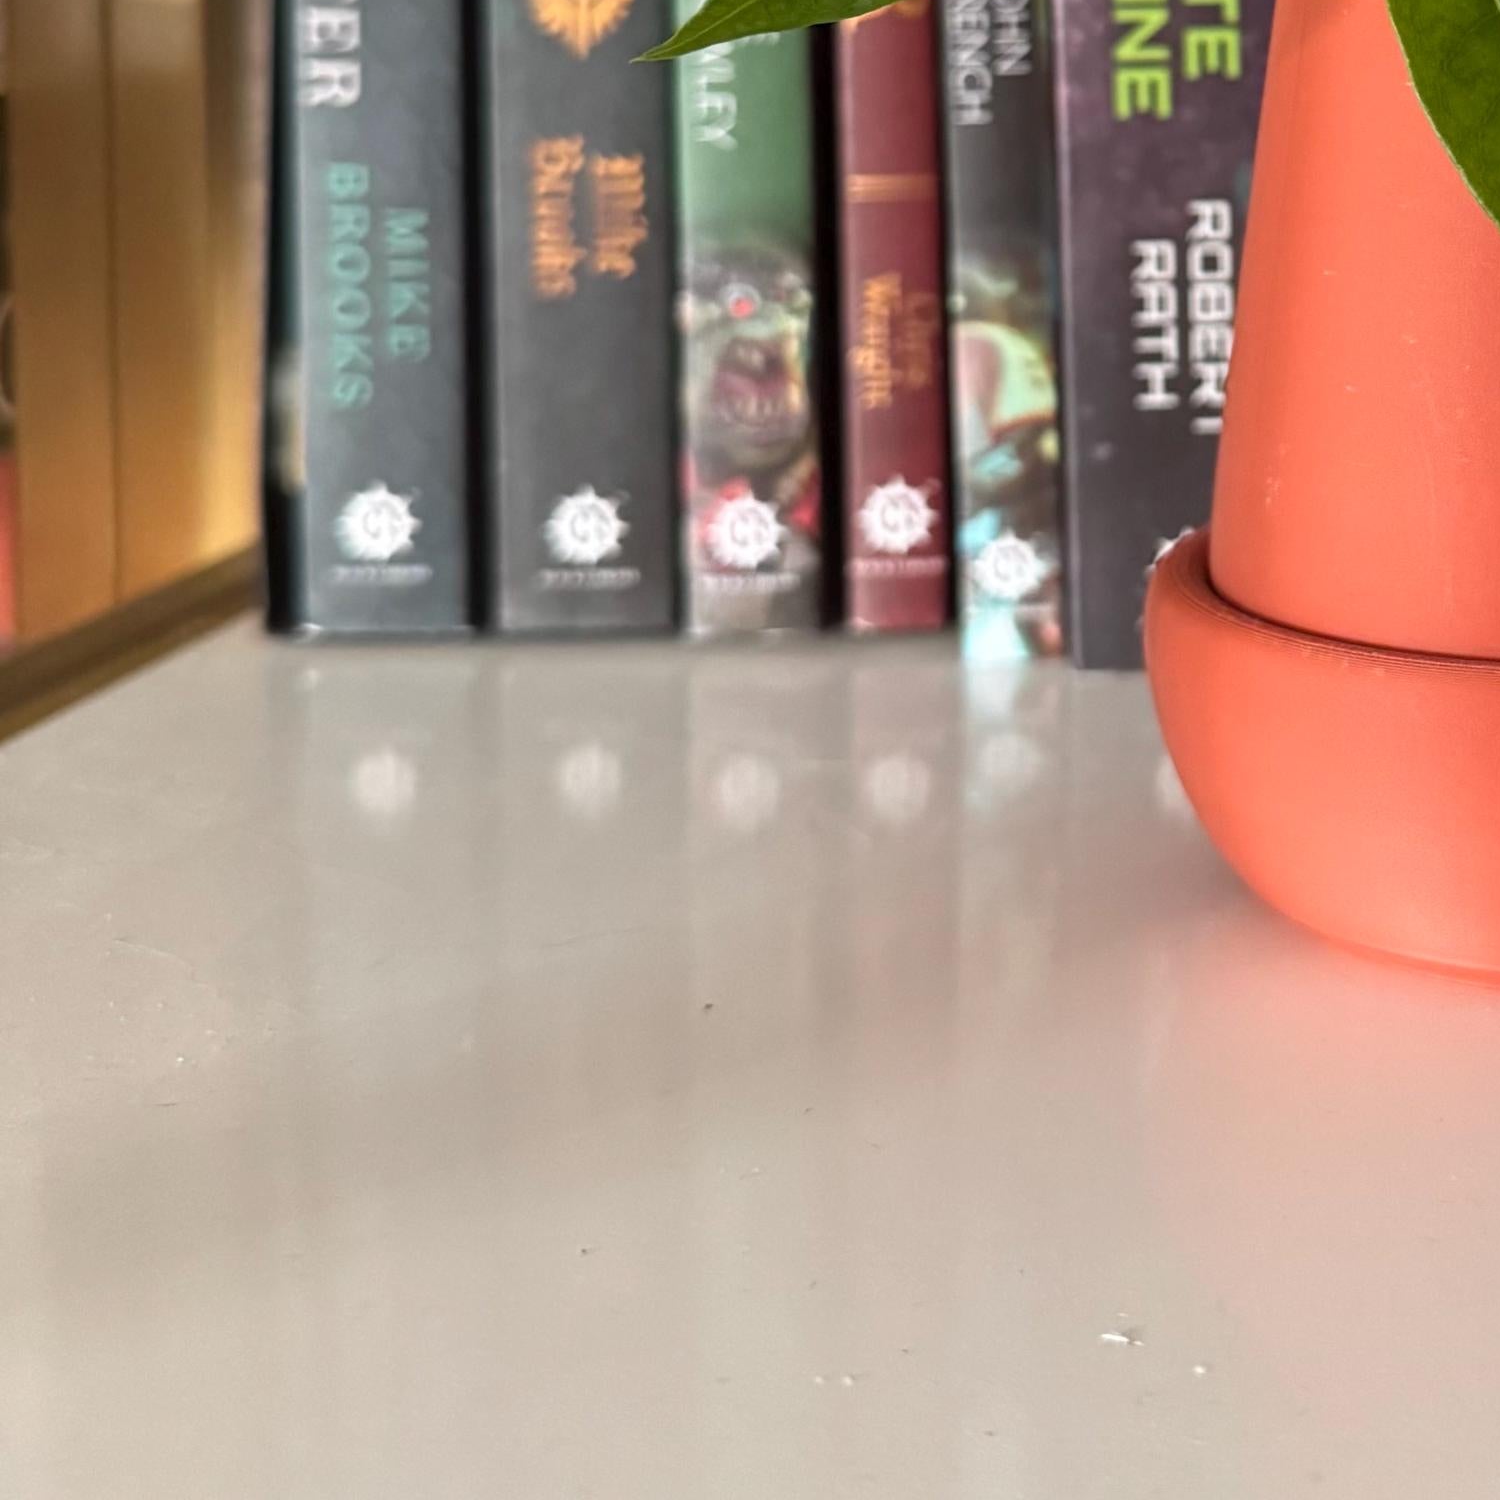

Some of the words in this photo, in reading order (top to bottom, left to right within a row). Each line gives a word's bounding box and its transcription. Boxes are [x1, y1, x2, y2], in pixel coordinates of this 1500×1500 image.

[327, 161, 375, 409] BROOKS
[384, 206, 432, 364] MIKE
[1130, 239, 1180, 411] RATH
